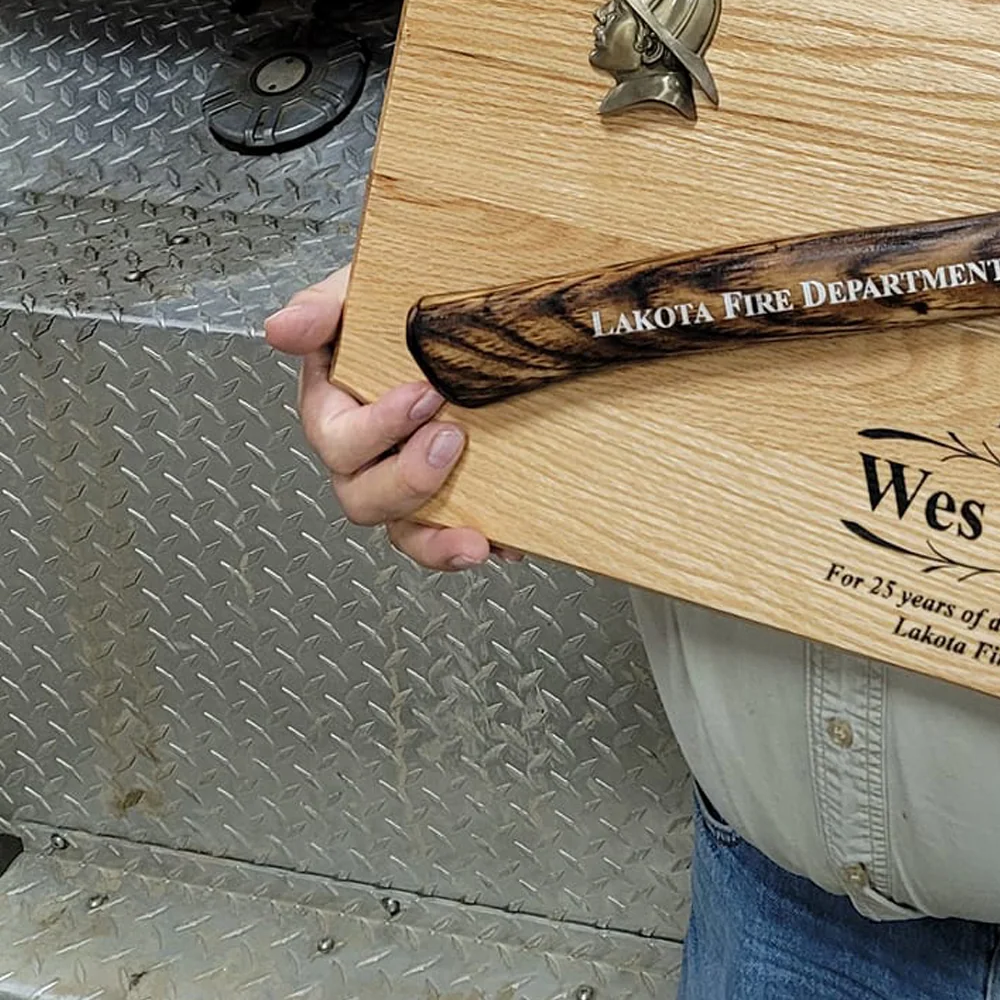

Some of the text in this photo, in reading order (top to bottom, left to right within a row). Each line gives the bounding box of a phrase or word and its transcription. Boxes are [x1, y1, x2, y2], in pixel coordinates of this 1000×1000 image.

[592, 308, 715, 338] LAKOTA
[723, 288, 794, 320] FIRE
[859, 451, 986, 541] Wes
[823, 562, 865, 590] For
[869, 576, 898, 600] 25
[896, 589, 957, 619] years
[960, 607, 990, 631] of
[891, 615, 968, 656] Lakota
